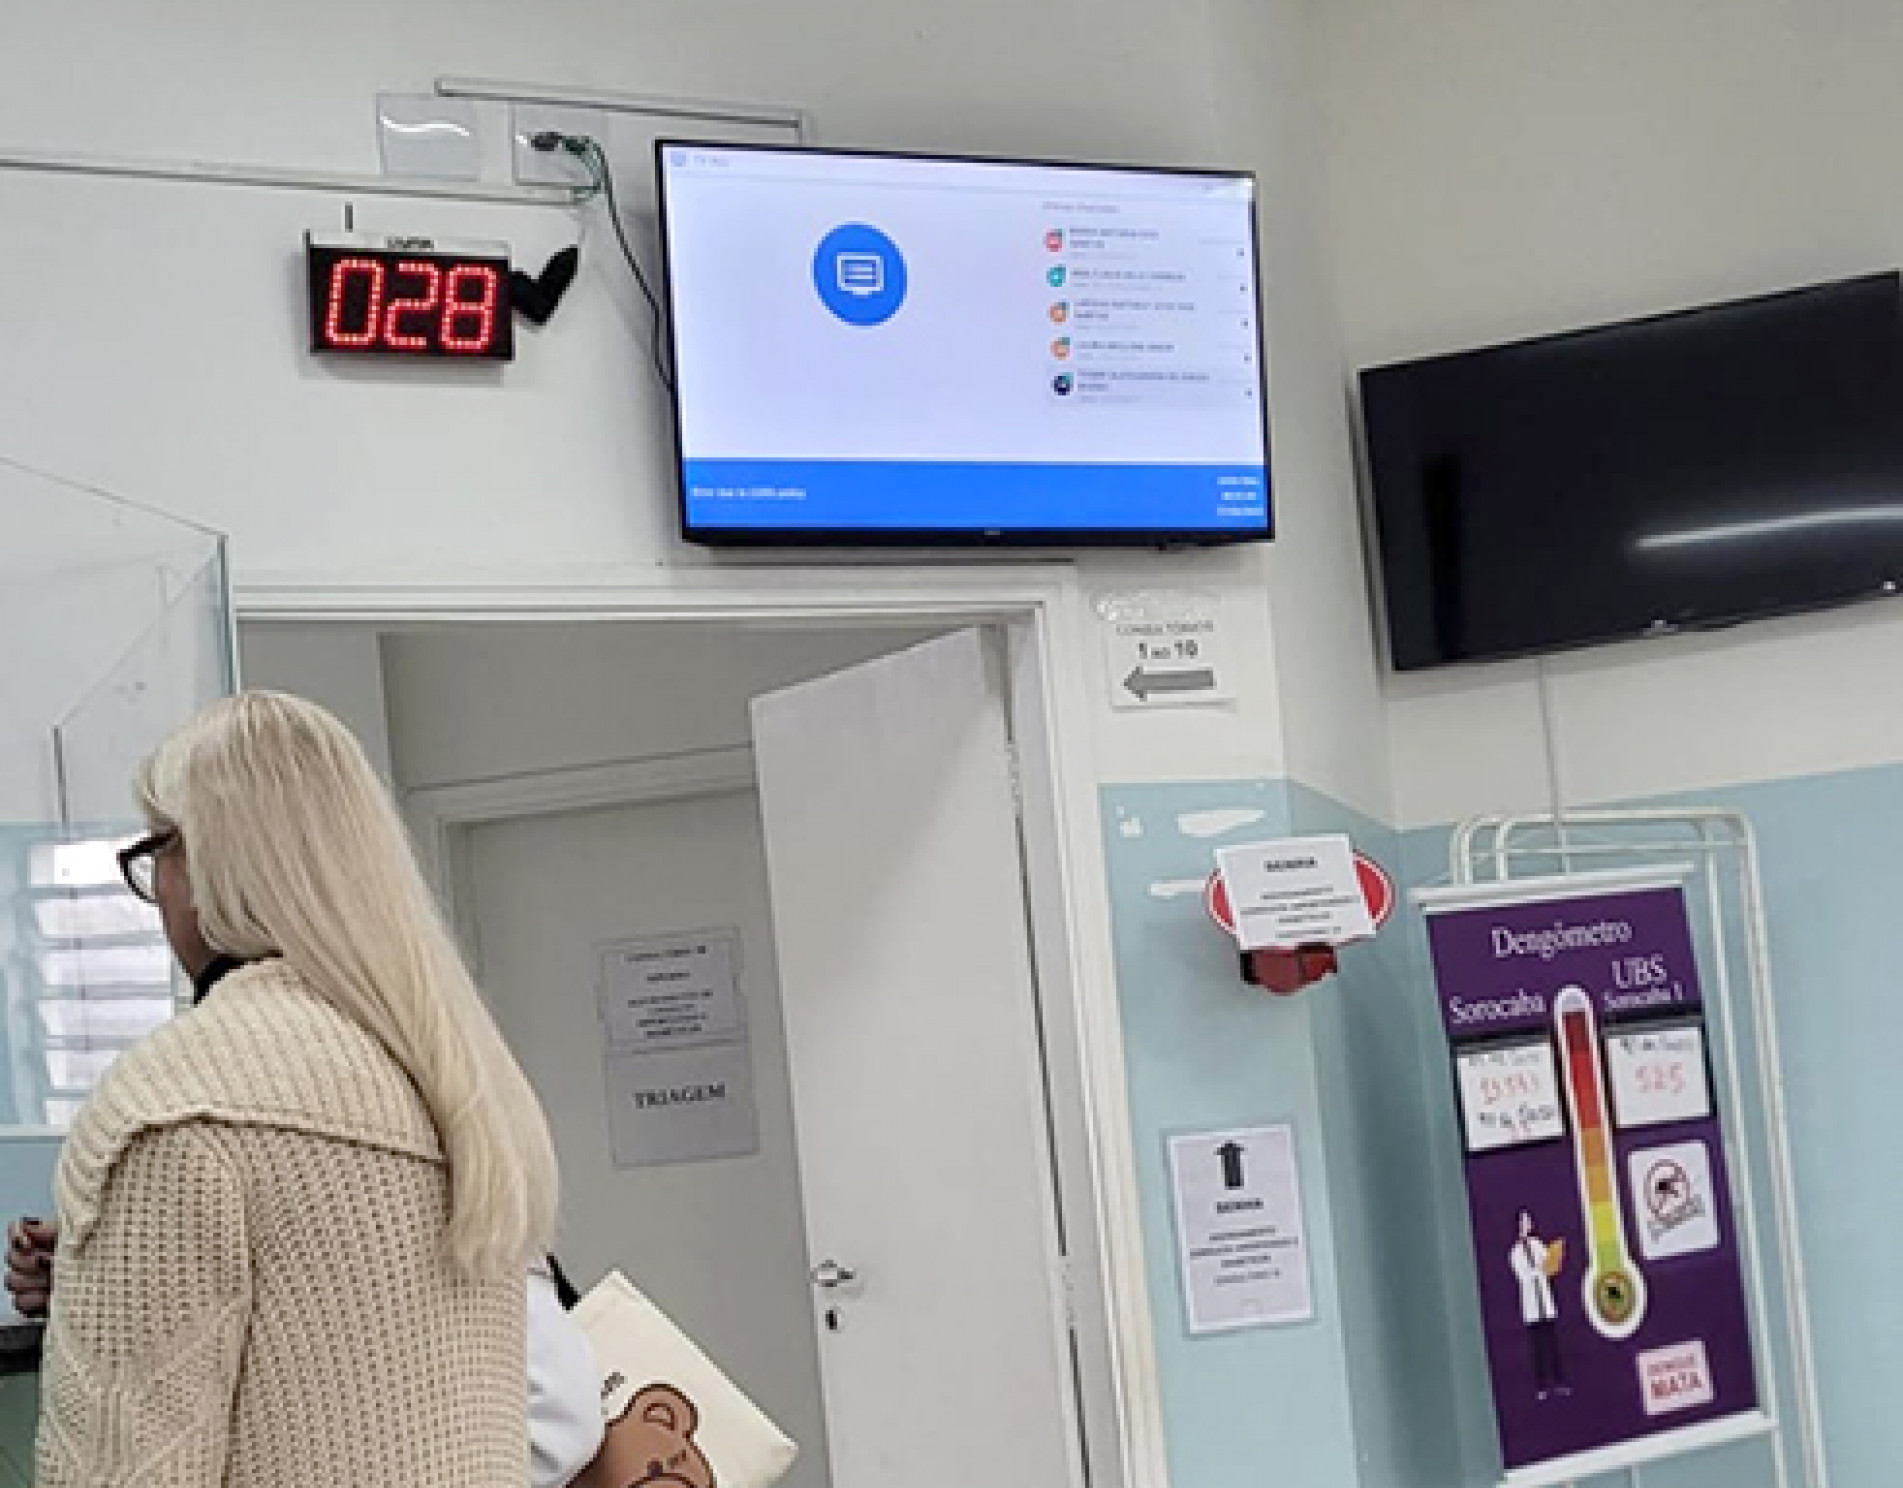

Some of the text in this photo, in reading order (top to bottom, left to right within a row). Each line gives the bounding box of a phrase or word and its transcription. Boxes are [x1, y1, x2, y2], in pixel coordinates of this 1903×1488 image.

[326, 258, 498, 350] 028
[1138, 642, 1148, 660] 1
[1174, 640, 1199, 660] 10
[1611, 954, 1668, 988] UBS
[1448, 988, 1547, 1025] Sorocaba
[634, 1082, 726, 1110] TRIAGEM
[1651, 1371, 1704, 1399] MATA
